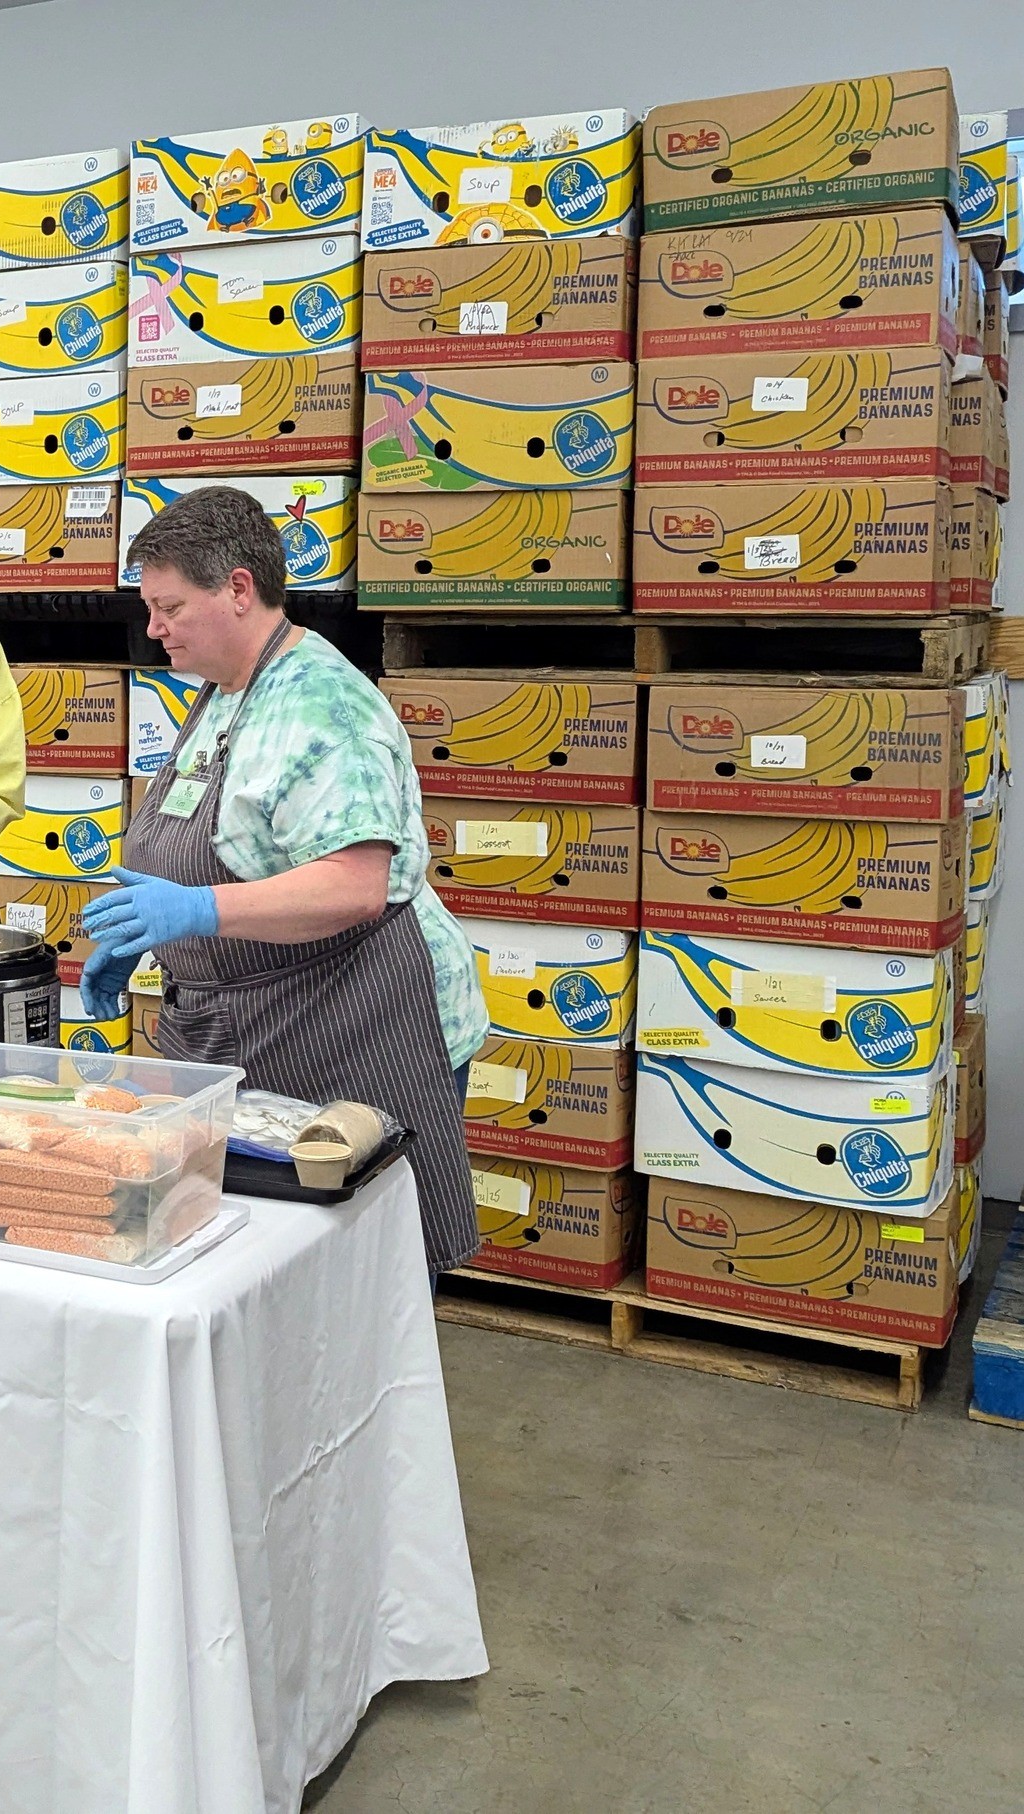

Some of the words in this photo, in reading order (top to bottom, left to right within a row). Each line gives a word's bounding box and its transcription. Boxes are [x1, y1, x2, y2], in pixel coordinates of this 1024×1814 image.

[667, 129, 720, 152] Dole
[835, 122, 935, 146] ORGANIC
[137, 180, 157, 194] ME4
[374, 176, 396, 189] ME4
[301, 178, 344, 215] Chiquita
[555, 182, 607, 220] Chiquita
[659, 199, 709, 215] CERTIFIED
[712, 191, 759, 207] ORGANIC
[762, 185, 815, 201] BANANAS
[825, 177, 880, 193] CERTIFIED
[884, 171, 935, 186] ORGANIC
[69, 212, 108, 246] Chiquita
[137, 229, 158, 238] SELECTED
[160, 220, 181, 231] QUALITY
[140, 233, 158, 244] CLASS
[160, 227, 182, 239] EXTRA
[371, 227, 398, 238] SELECTED
[399, 222, 422, 232] QUALITY
[374, 235, 394, 245] CLASS
[396, 228, 422, 241] EXTRA
[859, 255, 933, 271] PREMIUM
[389, 274, 433, 293] Dole
[554, 274, 618, 288] PREMIUM
[859, 272, 933, 289] BANANAS
[552, 290, 617, 306] BANANAS
[152, 386, 190, 403] Dole
[295, 383, 351, 397] PREMIUM
[668, 386, 719, 405] Dole
[860, 386, 934, 400] PREMIUM
[294, 398, 351, 412] BANANAS
[859, 404, 933, 419] BANANAS
[70, 435, 108, 466] Chiquita
[564, 436, 615, 471] Chiquita
[376, 468, 402, 477] ORGANIC
[403, 465, 423, 473] BANANA
[639, 460, 682, 471] PREMIUM
[683, 459, 728, 469] BANANAS
[736, 458, 779, 468] PREMIUM
[781, 457, 828, 467] BANANAS
[834, 455, 881, 466] PREMIUM
[883, 454, 931, 464] BANANAS
[375, 474, 401, 484] SELECTED
[402, 470, 426, 480] QUALITY
[380, 519, 424, 537] Dole
[664, 515, 715, 534] Dole
[855, 522, 929, 537] PREMIUM
[521, 536, 607, 549] ORGANIC
[854, 540, 928, 554] BANANAS
[366, 582, 411, 593] CERTIFIED
[413, 582, 454, 592] ORGANIC
[457, 582, 504, 592] BANANAS
[514, 582, 559, 592] CERTIFIED
[561, 581, 612, 592] ORGANIC
[65, 698, 115, 709] PREMIUM
[65, 712, 115, 723] BANANAS
[564, 718, 628, 733] PREMIUM
[139, 722, 153, 731] pop
[145, 729, 155, 737] by
[138, 735, 162, 745] nature
[563, 734, 627, 749] BANANAS
[869, 731, 942, 747] PREMIUM
[868, 748, 942, 764] BANANAS
[457, 773, 494, 783] PREMIUM
[496, 775, 536, 786] BANANAS
[541, 778, 581, 788] PREMIUM
[583, 781, 625, 791] BANANAS
[71, 839, 110, 866] Chiquita
[670, 837, 721, 857] Dole
[858, 857, 931, 875] PREMIUM
[857, 875, 930, 892] BANANAS
[561, 997, 609, 1028] Chiquita
[646, 1038, 670, 1046] CLASS
[858, 1028, 915, 1061] Chiquita
[547, 1078, 608, 1099] PREMIUM
[545, 1094, 607, 1115] BANANAS
[646, 1159, 671, 1167] CLASS
[853, 1157, 910, 1190] Chiquita
[677, 1208, 728, 1234] Dole
[864, 1248, 937, 1270] PREMIUM
[864, 1264, 937, 1287] BANANAS
